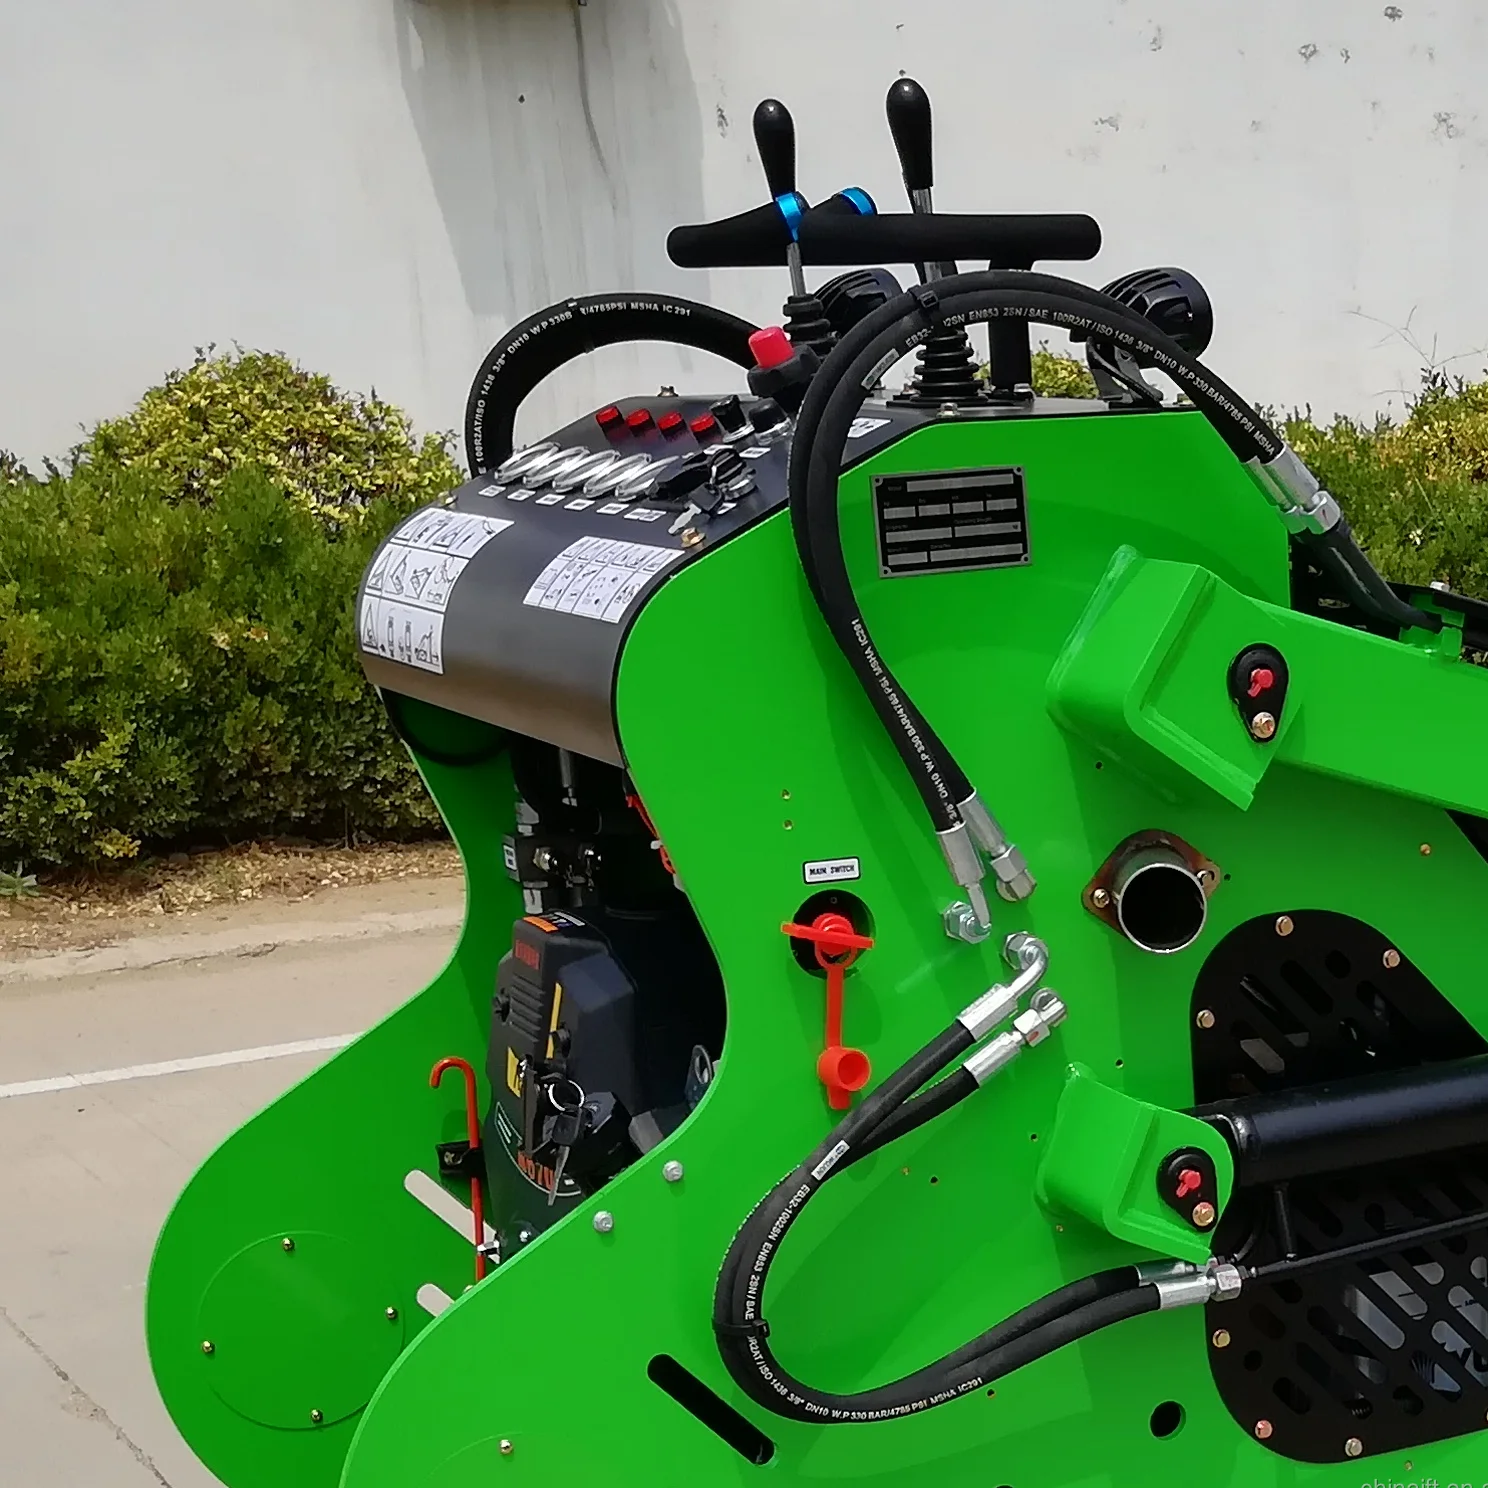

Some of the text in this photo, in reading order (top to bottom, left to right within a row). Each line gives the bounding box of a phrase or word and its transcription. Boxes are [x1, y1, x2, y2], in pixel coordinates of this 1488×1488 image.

[1154, 350, 1177, 368] DN10
[1253, 430, 1275, 455] MSHA
[804, 1401, 829, 1416] DN10
